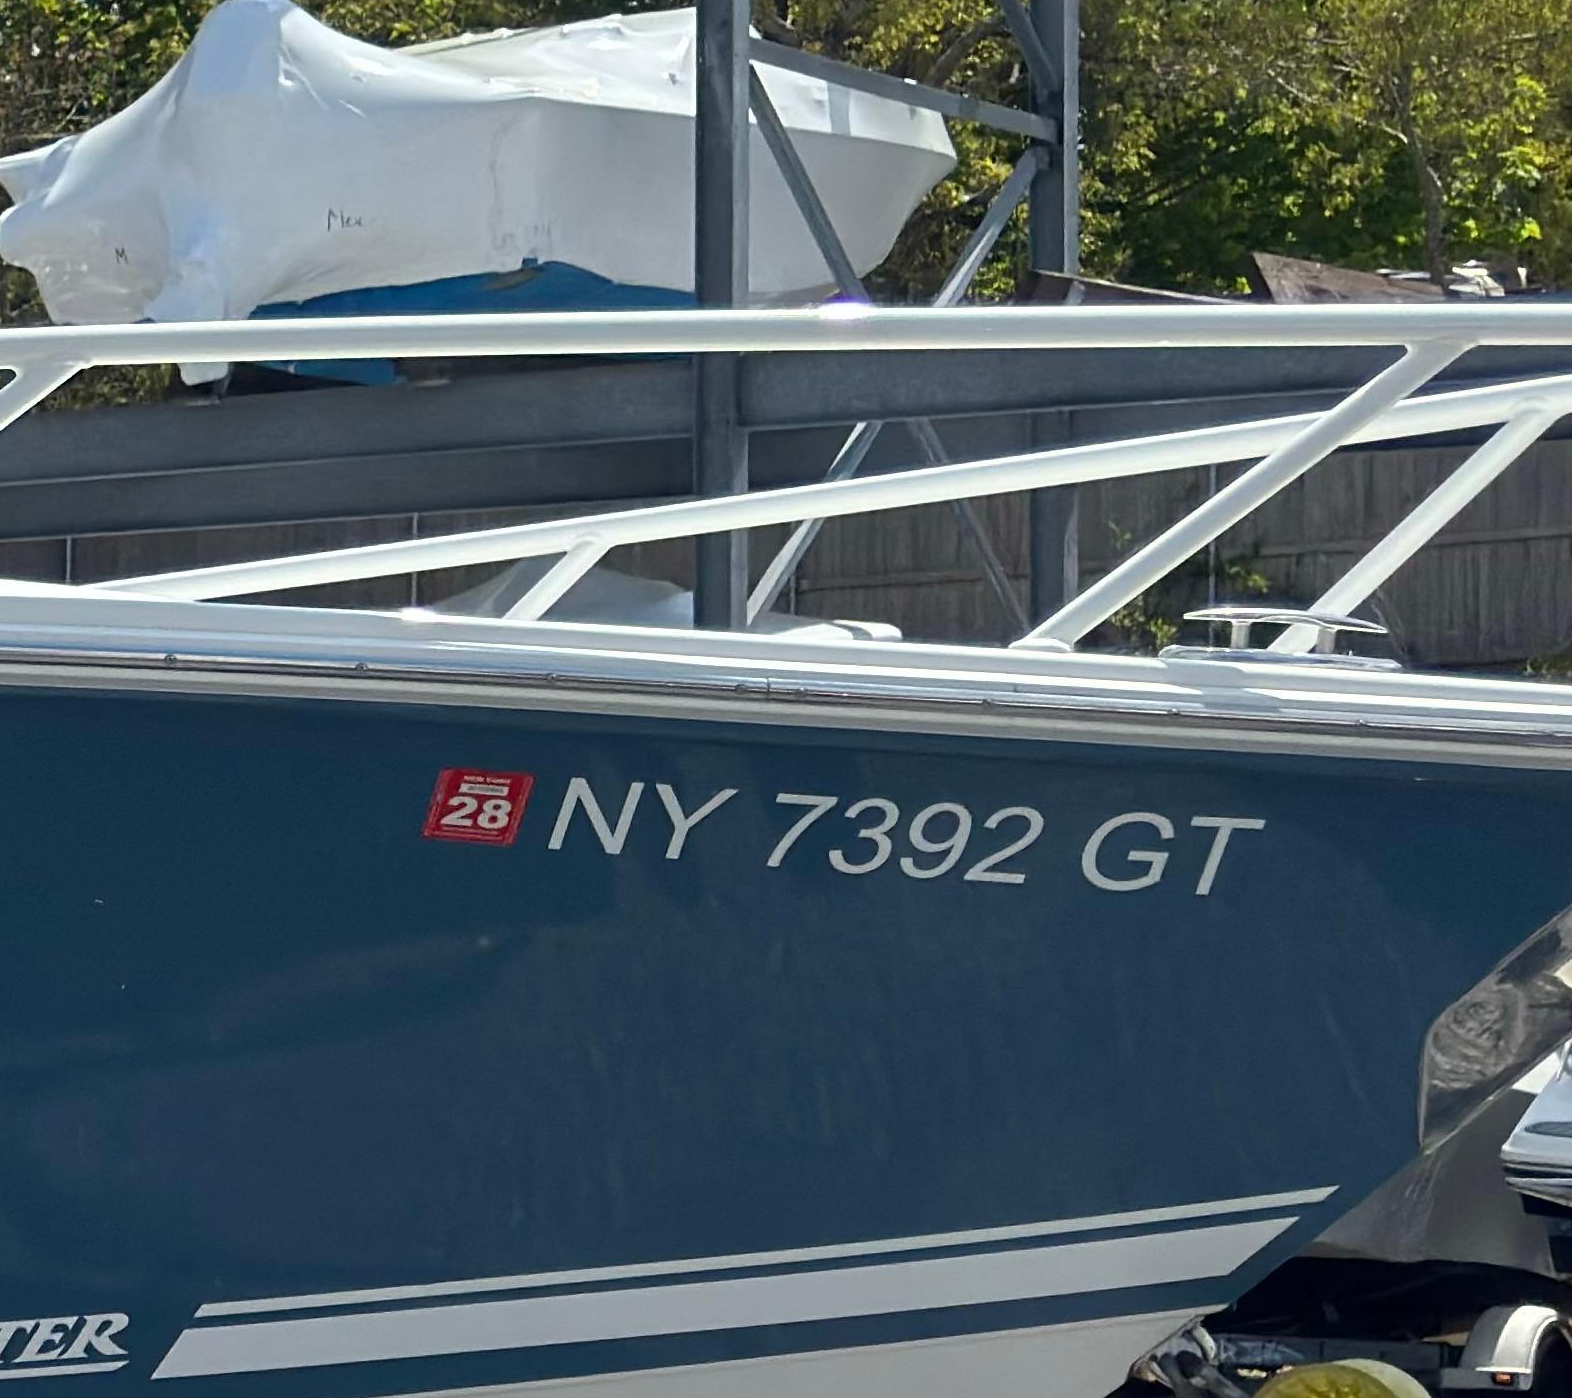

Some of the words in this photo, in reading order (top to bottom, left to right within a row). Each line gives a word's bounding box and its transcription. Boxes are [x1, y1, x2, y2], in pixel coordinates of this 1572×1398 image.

[440, 796, 512, 829] 28
[547, 777, 739, 860] NY
[767, 792, 1045, 884] 7392
[1081, 811, 1266, 896] GT
